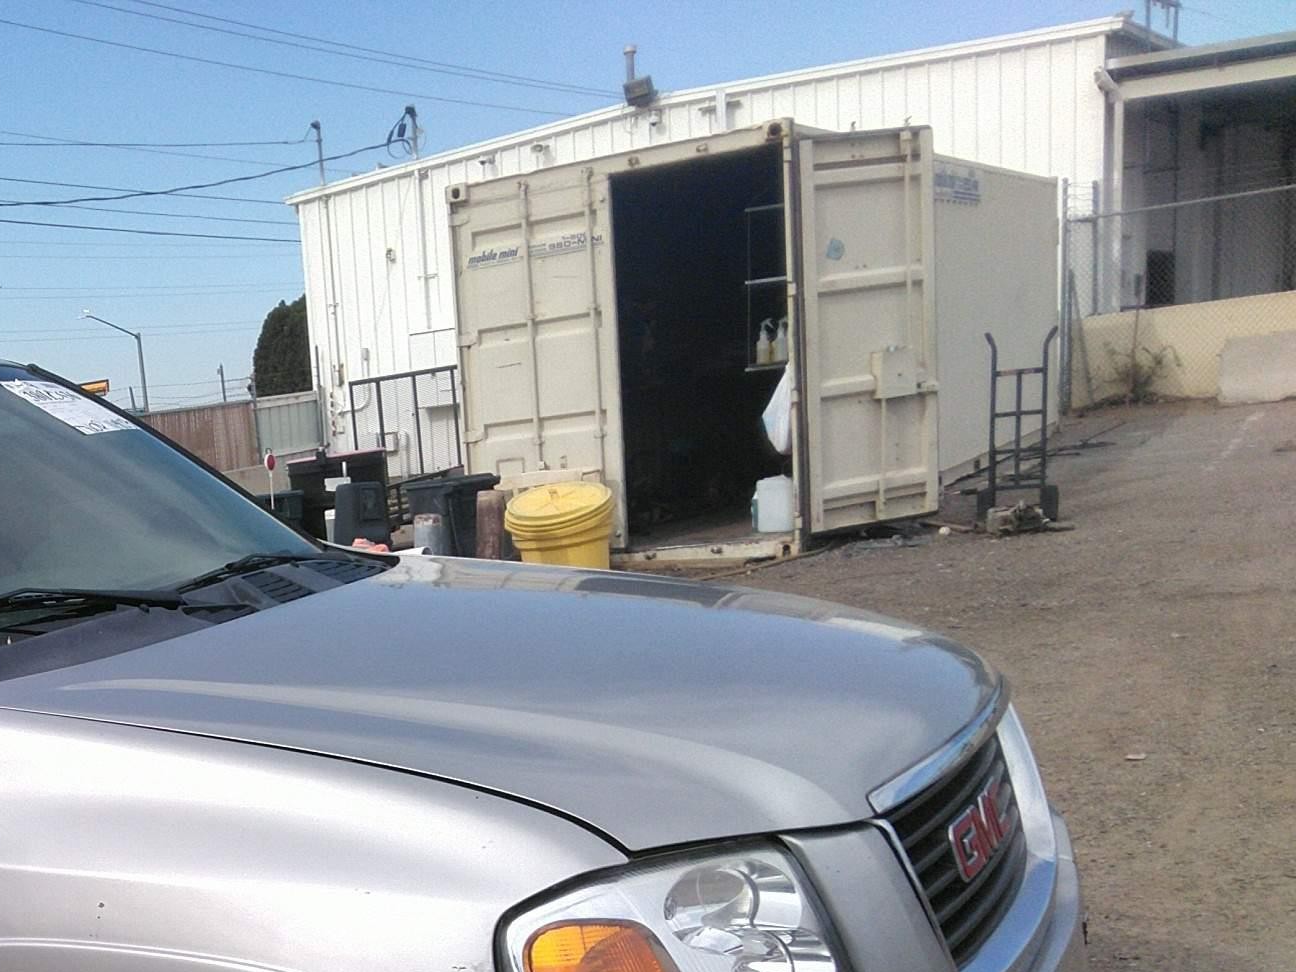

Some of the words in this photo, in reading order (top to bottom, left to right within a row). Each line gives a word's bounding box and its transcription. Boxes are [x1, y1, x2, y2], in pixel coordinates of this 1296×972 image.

[468, 249, 497, 265] mobile
[499, 247, 519, 259] mini
[947, 776, 1012, 884] GMC
